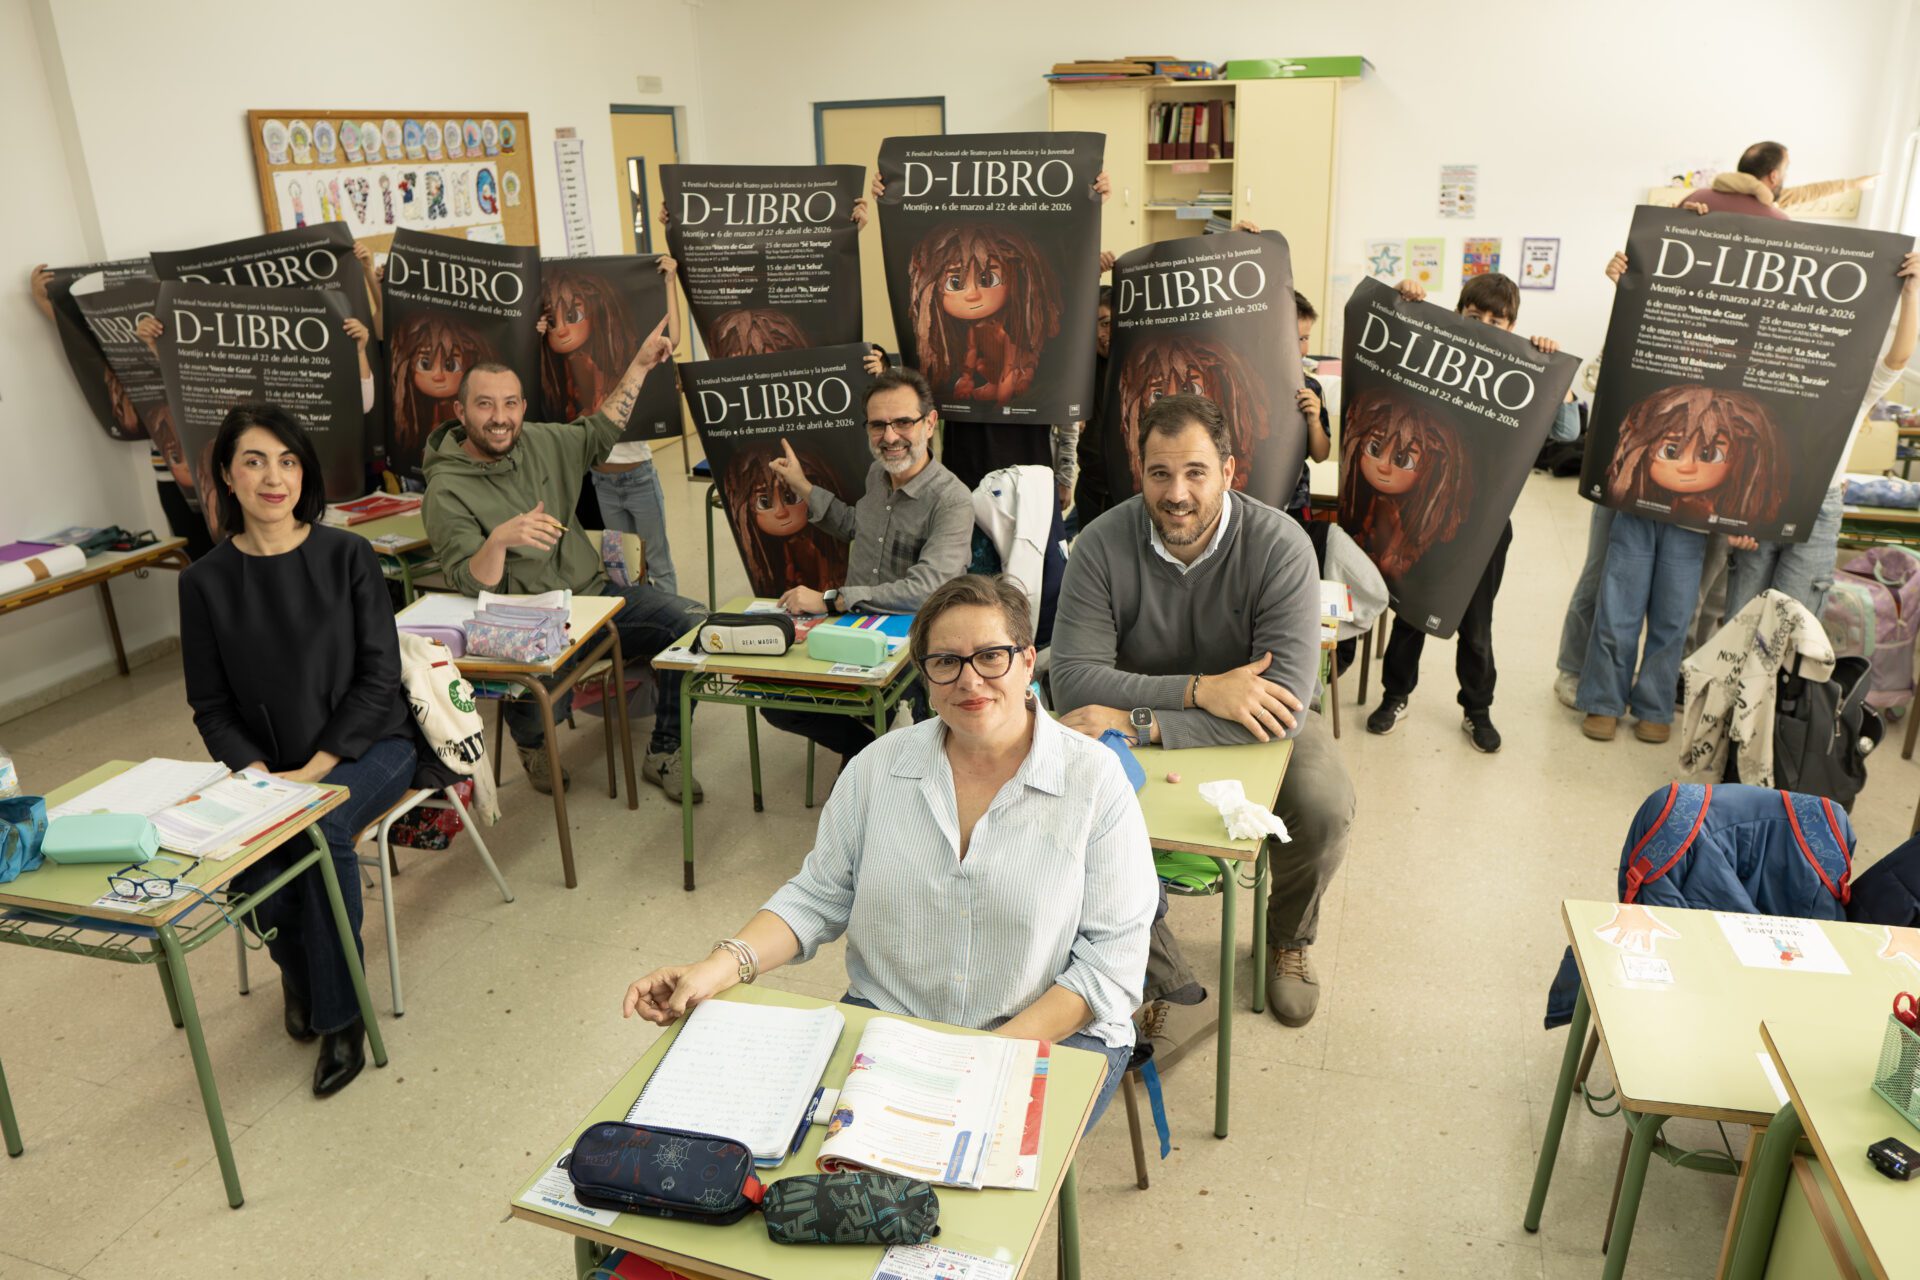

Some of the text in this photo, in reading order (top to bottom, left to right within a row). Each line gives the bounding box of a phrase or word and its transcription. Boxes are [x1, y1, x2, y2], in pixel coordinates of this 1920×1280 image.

[902, 159, 1074, 198] D-LIBRO
[681, 190, 836, 226] D-LIBRO
[903, 203, 933, 213] Montijo
[941, 203, 947, 211] 6
[948, 202, 959, 211] de
[986, 202, 994, 211] al
[995, 203, 1006, 211] 22
[1008, 202, 1018, 211] de
[1019, 202, 1037, 211] abril
[1039, 202, 1049, 211] de
[1051, 203, 1072, 211] 2026
[682, 230, 709, 239] Montijo
[717, 230, 722, 238] 6
[723, 230, 733, 238] de
[757, 229, 764, 237] al
[775, 228, 784, 236] de
[785, 227, 801, 235] abril
[802, 226, 812, 234] de
[813, 226, 832, 234] 2026
[1671, 225, 1697, 236] Festival
[1698, 229, 1731, 240] Nacional
[1732, 234, 1742, 242] de
[1743, 235, 1765, 245] Teatro
[1766, 239, 1783, 247] para
[1784, 240, 1792, 248] la
[1793, 241, 1823, 252] Infancia
[1831, 246, 1838, 254] la
[1840, 247, 1874, 258] Juventud
[388, 251, 524, 305] D-LIBRO
[1118, 260, 1267, 315] D-LIBRO
[1652, 237, 1868, 304] D-LIBRO
[1140, 318, 1145, 326] 6
[1145, 316, 1154, 325] de
[1155, 316, 1178, 324] marzo
[1180, 313, 1188, 322] al
[1189, 312, 1200, 321] 22
[1202, 310, 1213, 319] de
[1214, 306, 1233, 317] abril
[1235, 305, 1246, 314] de
[1247, 302, 1268, 313] 2026
[1650, 282, 1855, 320] Montijo 6 de marzo al 22 de abril de 2026
[1653, 300, 1663, 308] de
[1664, 303, 1687, 312] marzo
[1713, 308, 1723, 317] de
[173, 309, 330, 353] D-LIBRO
[177, 348, 204, 359] Montijo
[217, 351, 227, 359] de
[252, 353, 259, 361] al
[260, 354, 270, 362] 22
[271, 354, 280, 362] de
[281, 354, 299, 363] abril
[300, 355, 310, 364] de
[311, 356, 331, 365] 2026
[1357, 312, 1536, 411] D-LIBRO
[697, 376, 852, 425] D-LIBRO
[1355, 352, 1520, 428] Montijo 6 de marzo al 22 de abril de 2026
[708, 418, 855, 439] Montijo 6 de marzo al 22 de abril de 2026
